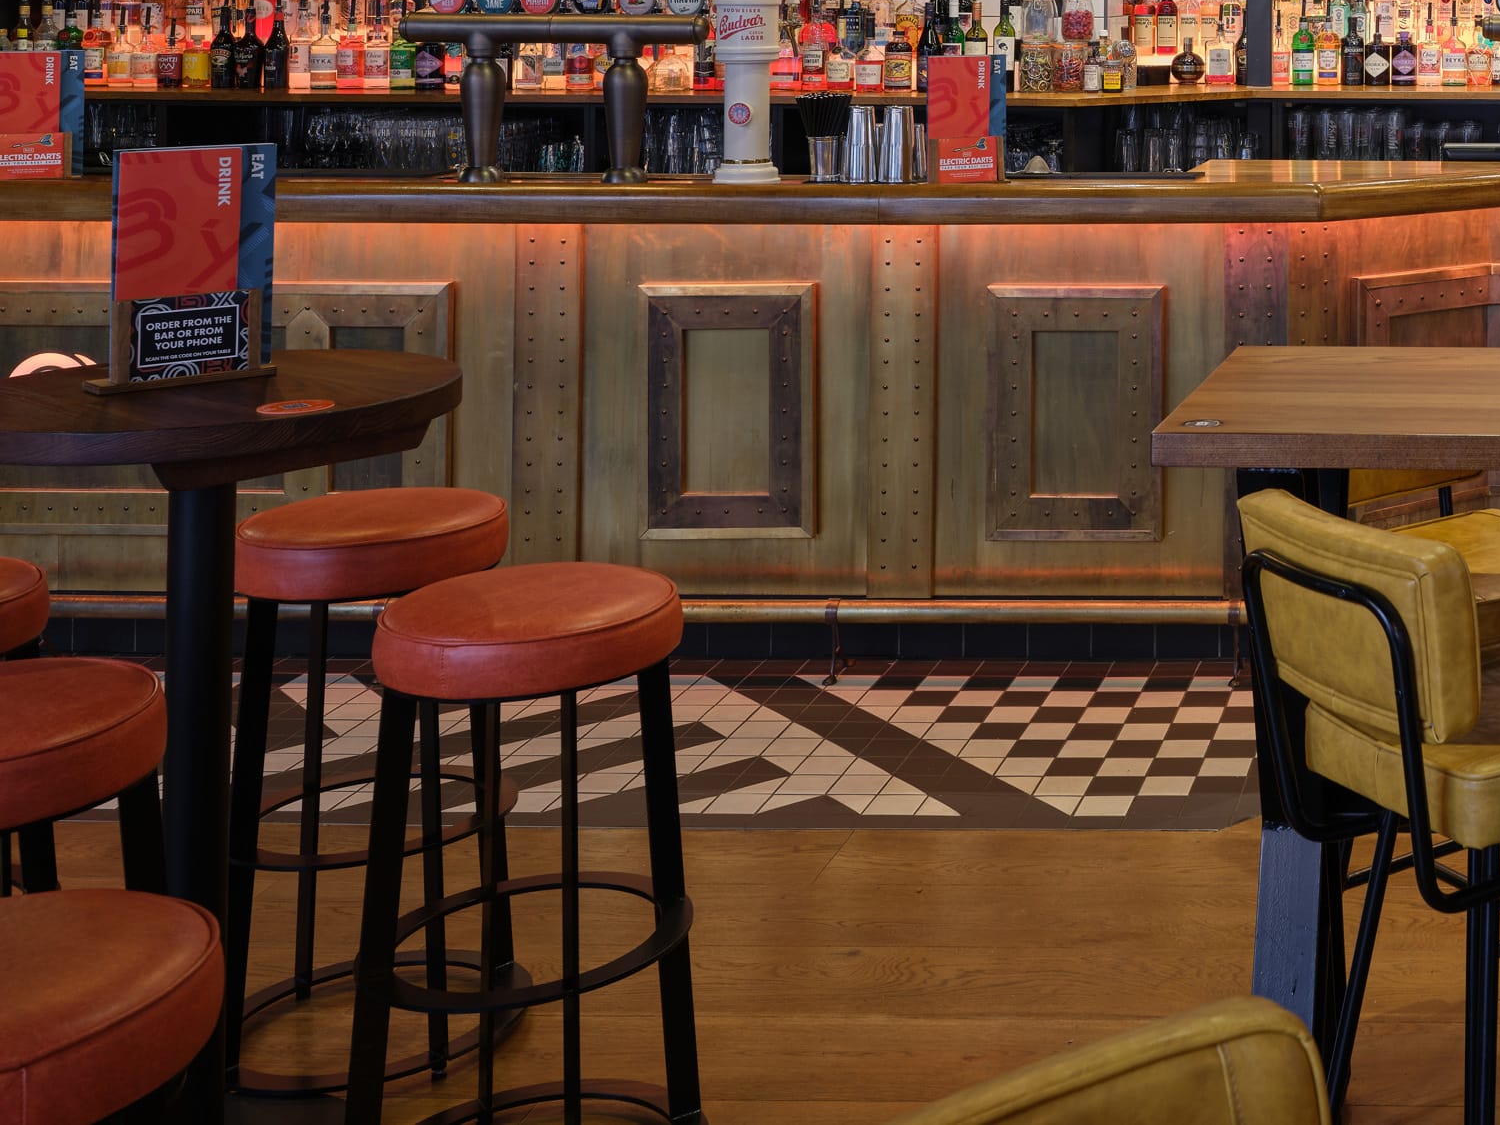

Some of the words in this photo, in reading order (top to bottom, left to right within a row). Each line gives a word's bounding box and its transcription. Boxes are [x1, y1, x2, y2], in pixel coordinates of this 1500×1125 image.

[485, 0, 505, 9] JANE
[719, 14, 766, 35] Budvar
[45, 56, 55, 85] DRINK
[69, 55, 78, 71] EAT
[978, 60, 986, 89] DRINK
[0, 154, 34, 162] LECTRIC
[34, 153, 62, 161] DARTS
[940, 157, 971, 166] ELECTRIC
[971, 156, 994, 165] DARTS
[251, 153, 264, 179] EAT
[218, 157, 232, 207] DRINK
[146, 321, 180, 331] ORDER
[183, 318, 212, 327] FROM
[214, 316, 232, 324] THE
[154, 332, 174, 340] BAR
[177, 329, 192, 338] OR
[194, 327, 224, 336] FROM
[155, 341, 184, 351] YOUR
[187, 337, 223, 347] PHONE
